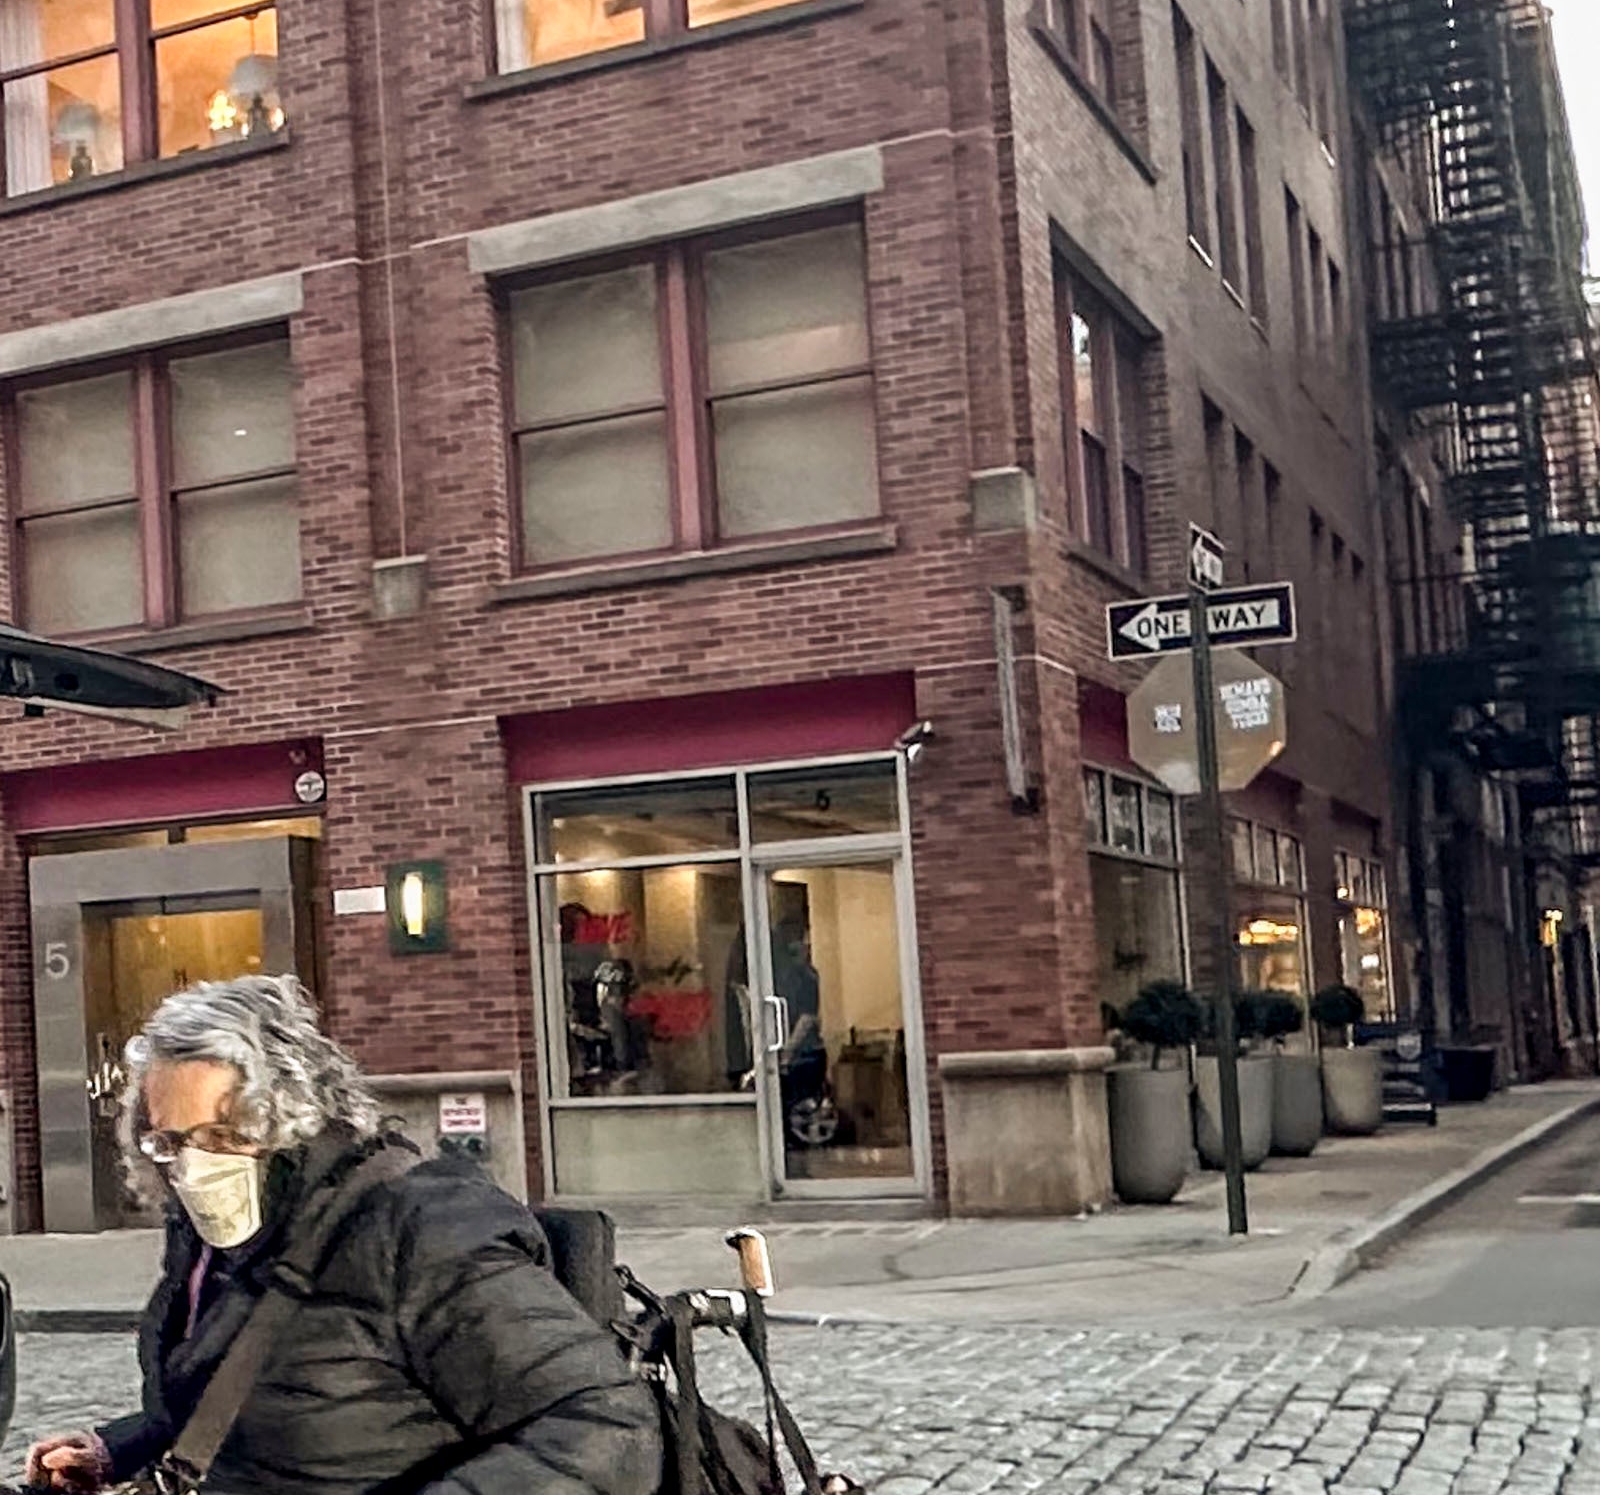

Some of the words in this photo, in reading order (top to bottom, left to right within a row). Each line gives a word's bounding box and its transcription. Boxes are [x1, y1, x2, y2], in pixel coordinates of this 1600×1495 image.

[1136, 613, 1186, 639] ONE
[1212, 604, 1266, 630] WAY
[45, 942, 69, 979] 5
